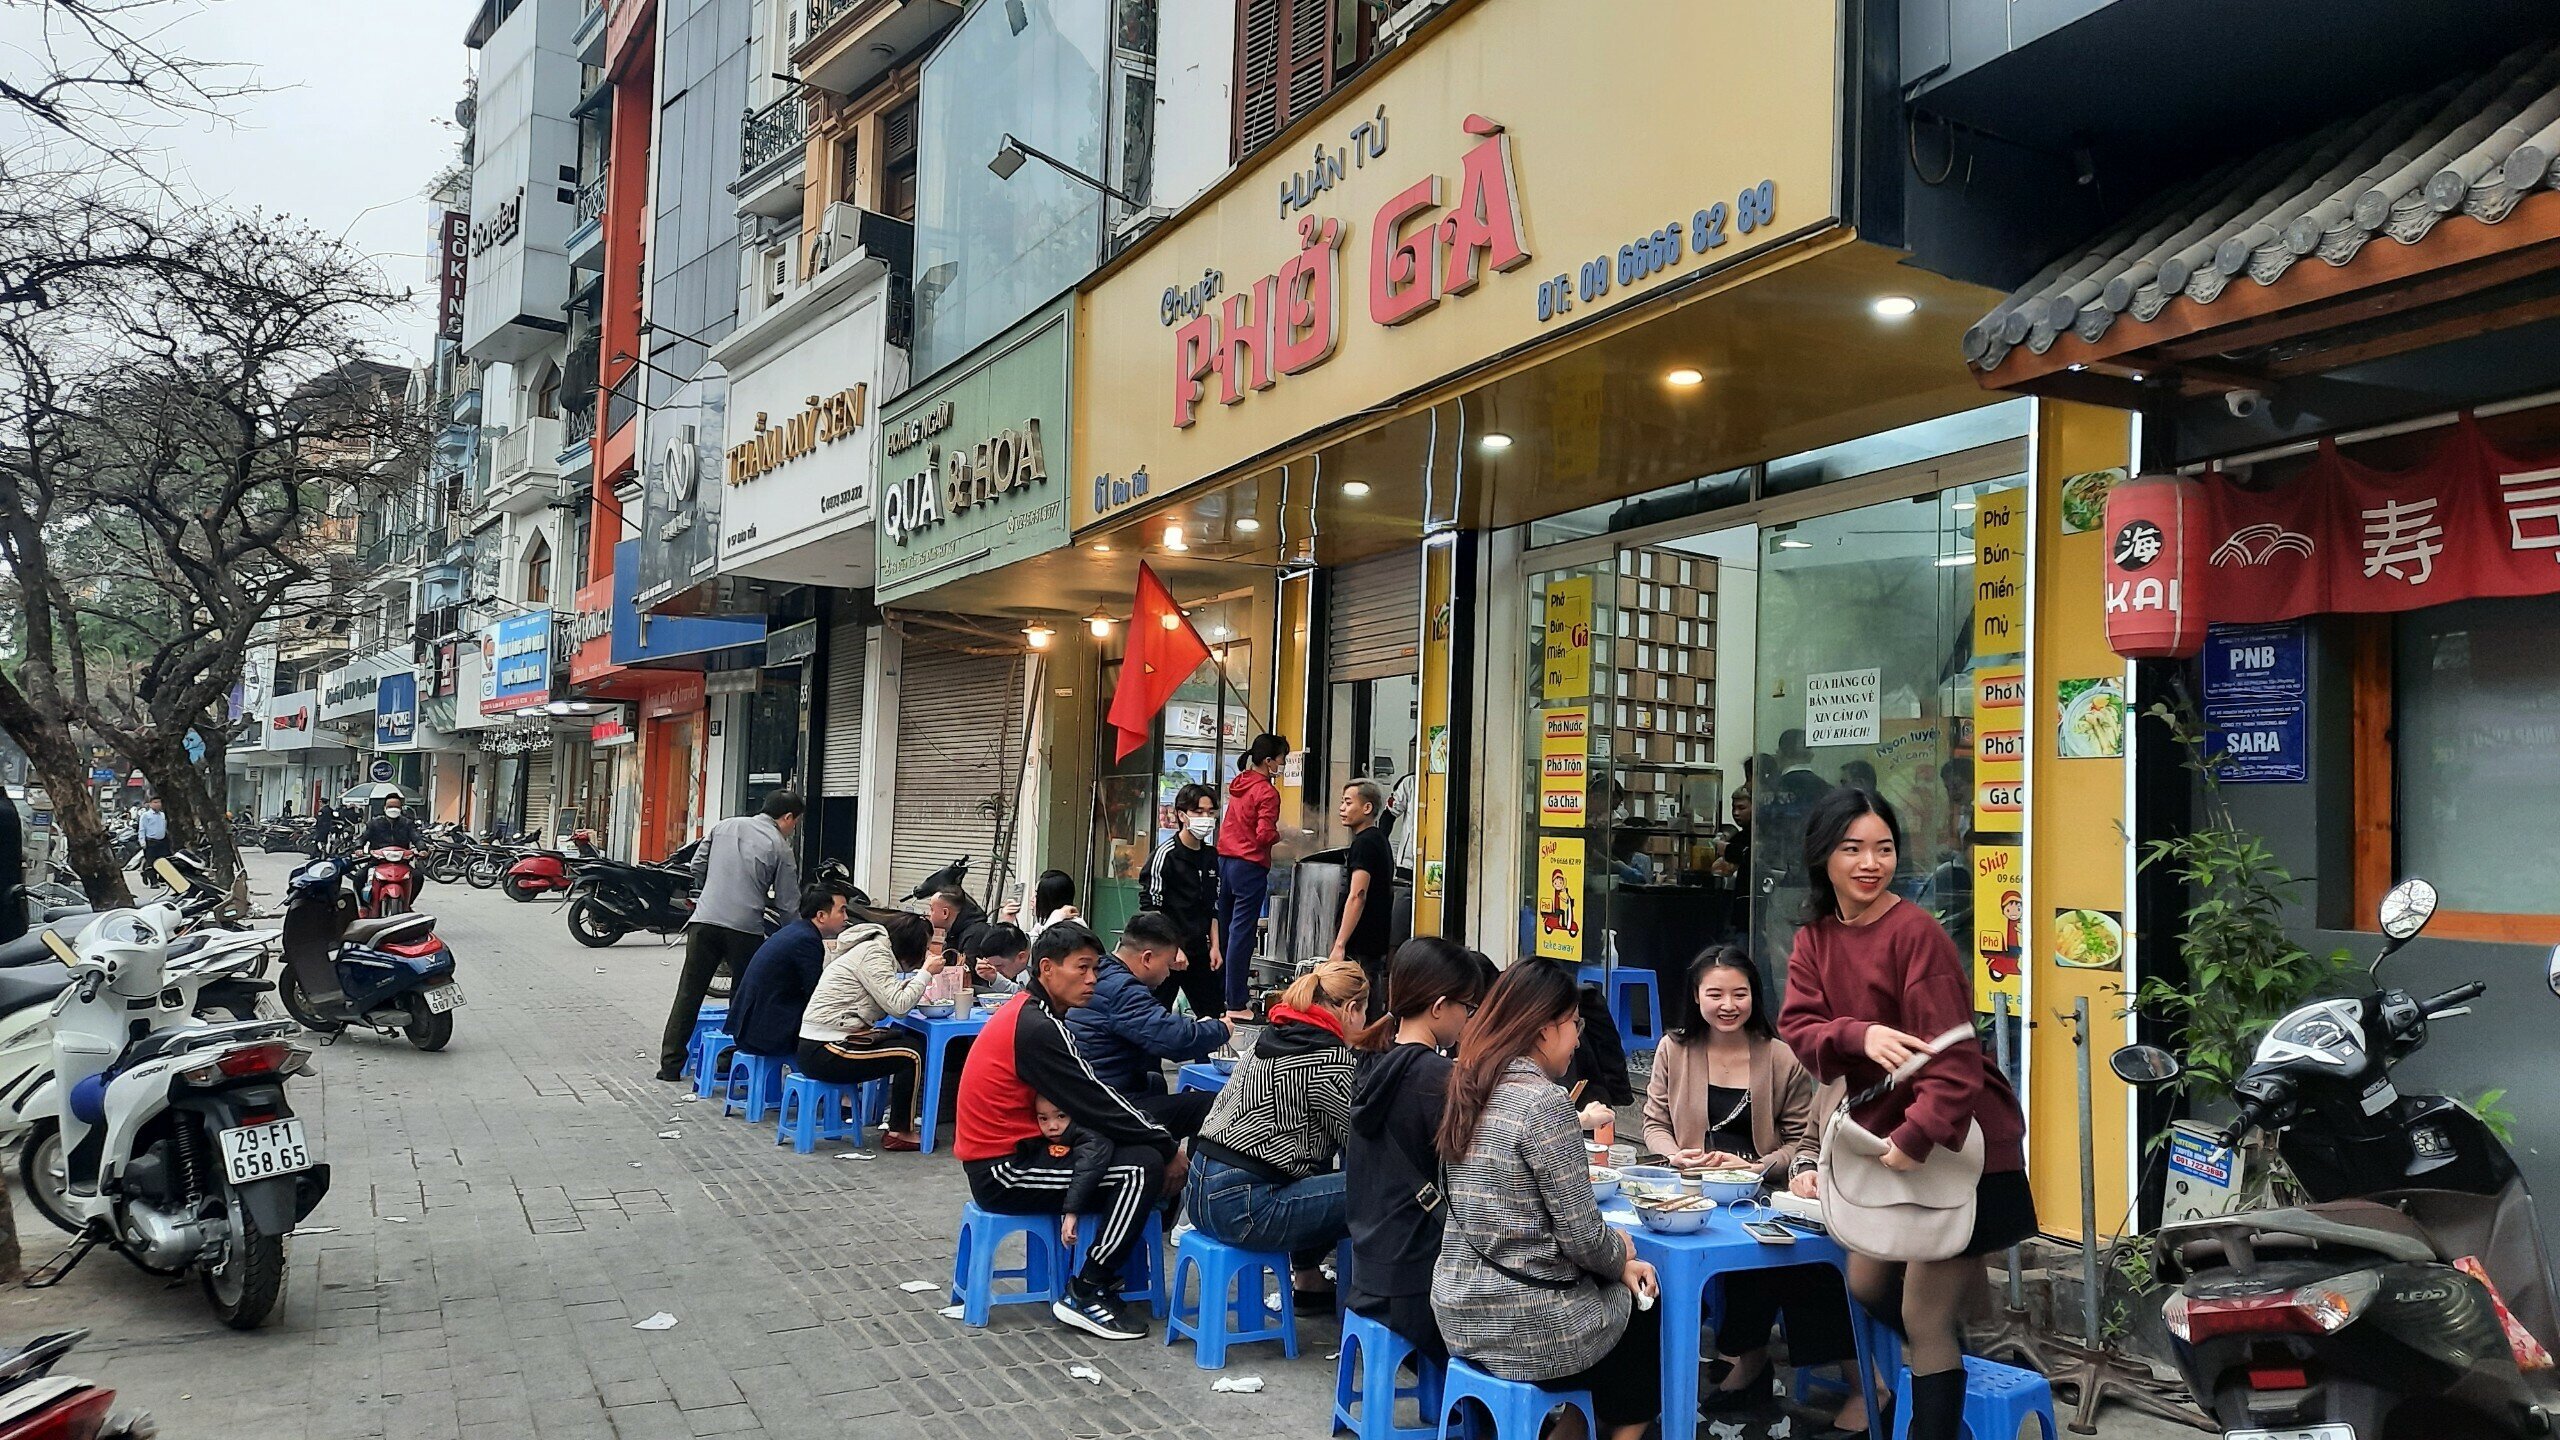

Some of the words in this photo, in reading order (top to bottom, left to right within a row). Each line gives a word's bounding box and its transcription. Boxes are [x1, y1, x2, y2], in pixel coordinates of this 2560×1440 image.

[1350, 104, 1390, 169] TÚ
[1538, 273, 1572, 322] ĐT:
[1579, 255, 1611, 302] 09
[1618, 221, 1682, 286] 6666
[1692, 201, 1728, 254] 82
[1737, 179, 1776, 234] 89
[1172, 214, 1348, 430] PHỞ
[1369, 114, 1532, 326] GÀ
[1161, 267, 1224, 327] Chuyên
[726, 411, 785, 488] THẨM
[784, 395, 821, 462] MỸ
[820, 382, 868, 445] SEN
[888, 418, 922, 457] HOÀNG
[884, 442, 946, 548] QUẢ
[947, 450, 972, 515] &
[972, 417, 1048, 506] HOA
[1095, 473, 1109, 514] 61
[1984, 506, 2010, 529] Phở
[1983, 544, 2010, 565] Bún
[2114, 526, 2163, 565] 海
[1979, 575, 2014, 601] Miến
[2107, 578, 2179, 614] KAI
[1551, 591, 1565, 608] Phở
[1550, 618, 1564, 634] Bún
[1571, 622, 1589, 648] Gà
[1547, 642, 1566, 660] Miến
[2230, 646, 2275, 671] PNB
[1831, 675, 1859, 688] HÀNG
[1861, 673, 1876, 685] CÓ
[1809, 693, 1828, 707] BÁN
[1831, 693, 1860, 705] MANG
[1985, 683, 2012, 700] Phở
[1548, 720, 1562, 733] Phở
[1563, 720, 1583, 732] Nước
[1814, 711, 1829, 723] XIN
[1812, 726, 1832, 742] QUÝ
[1834, 725, 1871, 739] KHÁCH!
[2226, 731, 2280, 753] SARA
[1985, 736, 2014, 755] Phở
[1547, 758, 1562, 771] Phở
[1564, 759, 1582, 773] Trộn
[1548, 795, 1559, 808] Gà
[1989, 788, 2009, 805] Gà
[1541, 841, 1557, 859] Ship
[1979, 851, 2008, 877] Ship
[1997, 873, 2008, 883] 09
[1982, 936, 1999, 948] Phở
[233, 1122, 295, 1154] 29-F1
[233, 1146, 307, 1180] 658.65
[2395, 1288, 2448, 1302] LEAD
